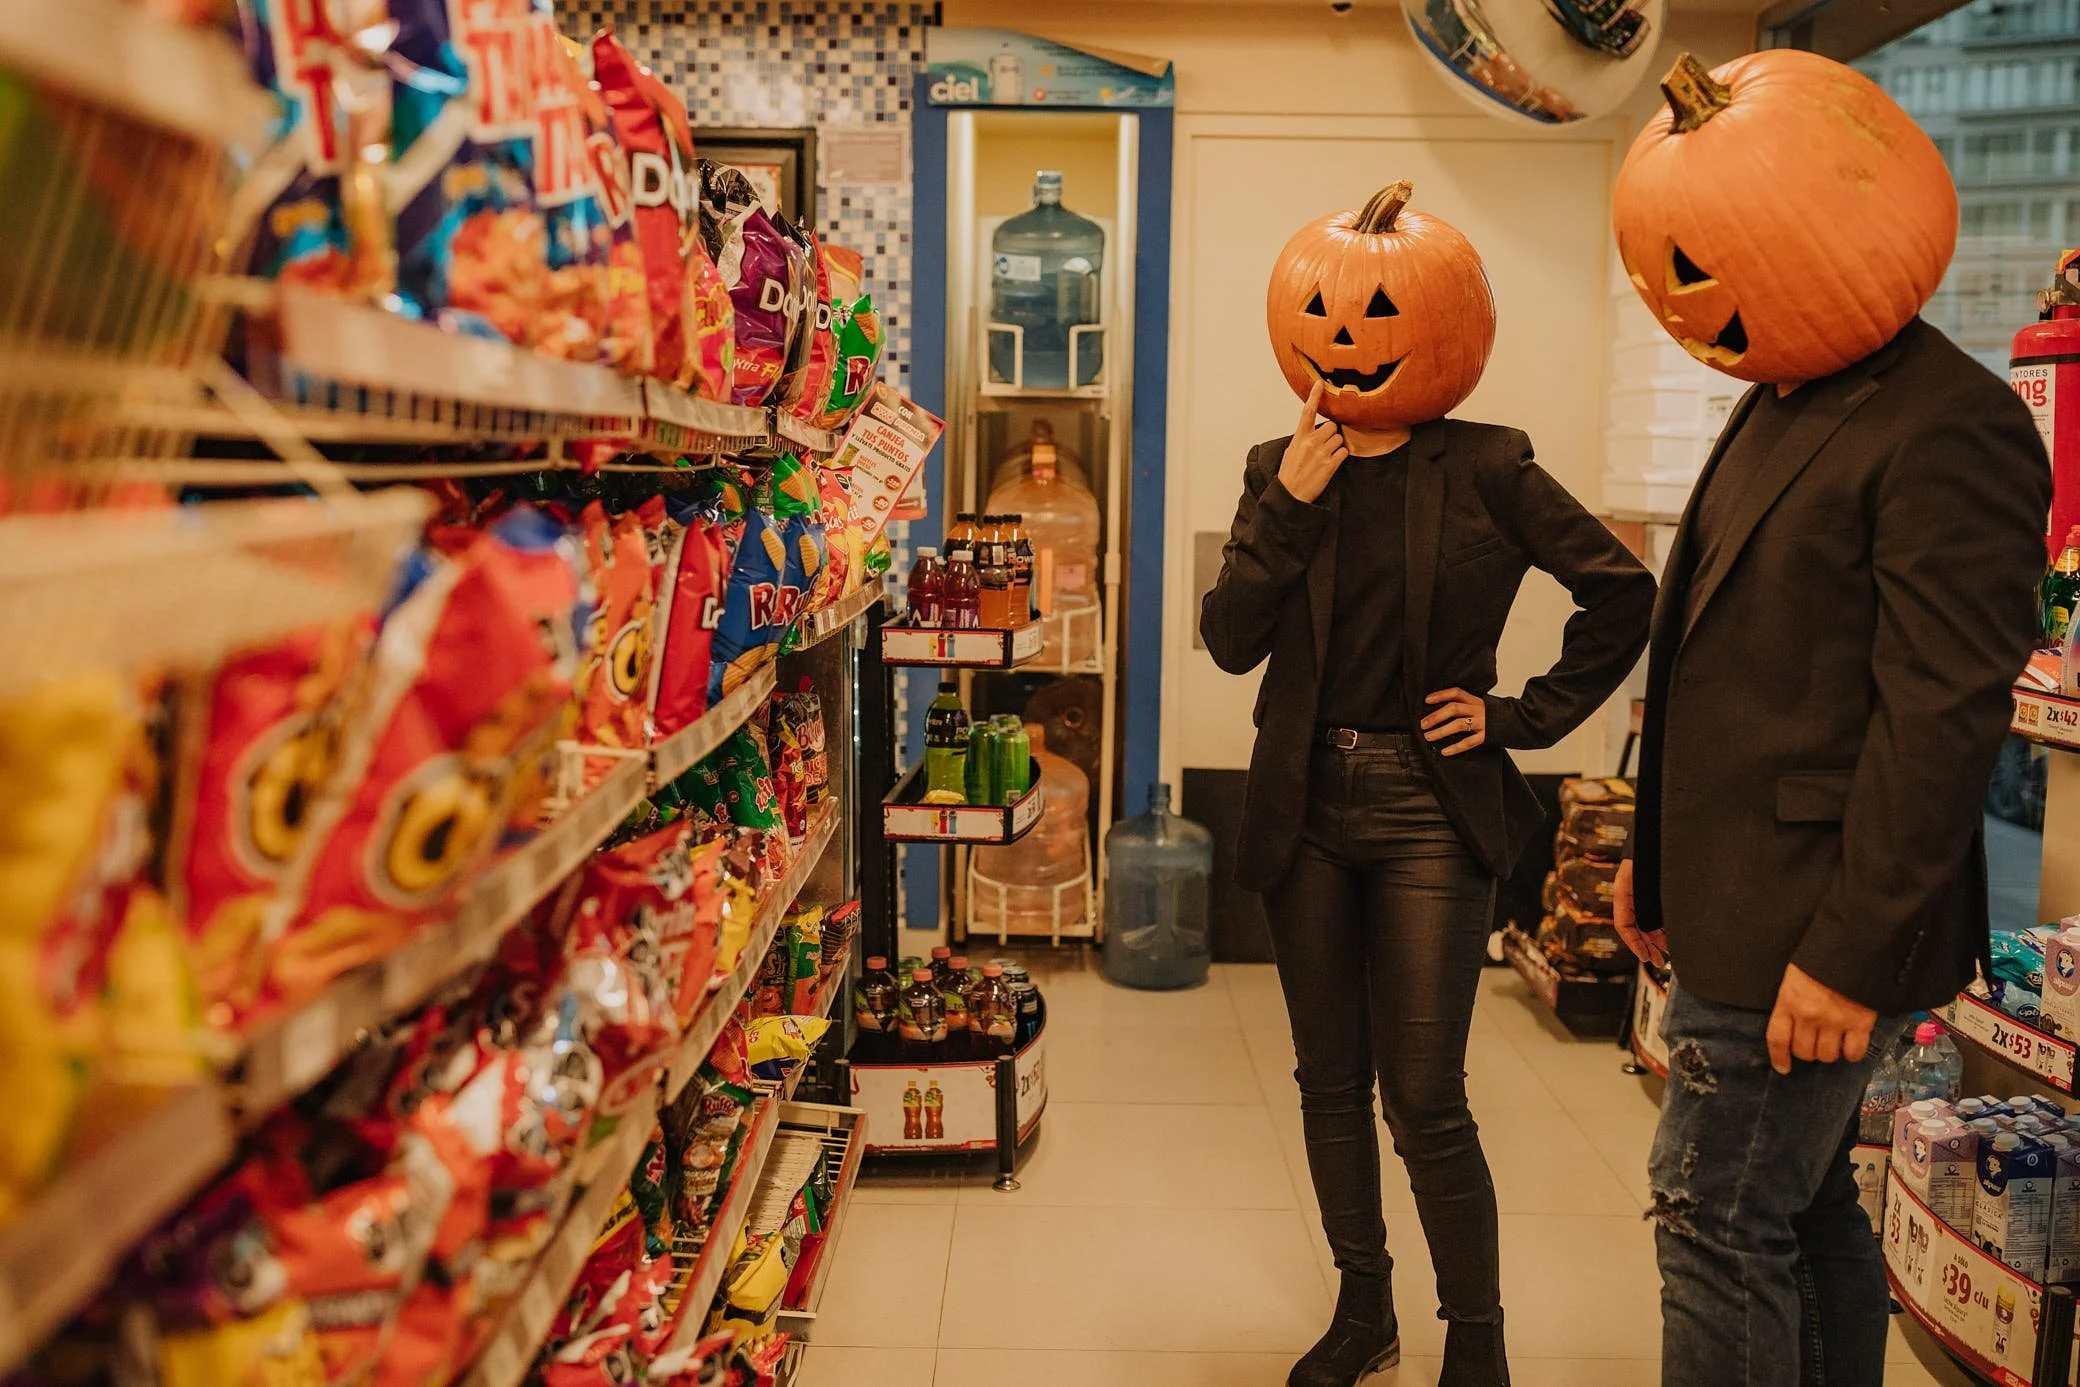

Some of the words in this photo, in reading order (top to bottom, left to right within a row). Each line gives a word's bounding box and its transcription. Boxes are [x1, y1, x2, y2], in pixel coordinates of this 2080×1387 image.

[930, 73, 978, 101] ciel
[899, 406, 913, 420] CON
[862, 428, 878, 444] TUS
[878, 438, 910, 463] PUNTOS
[876, 425, 905, 448] CANJEA
[872, 445, 896, 463] PRODUCTO
[895, 460, 911, 473] GRATIS
[1942, 1263, 1972, 1305] $39
[1973, 1291, 1990, 1310] c/u
